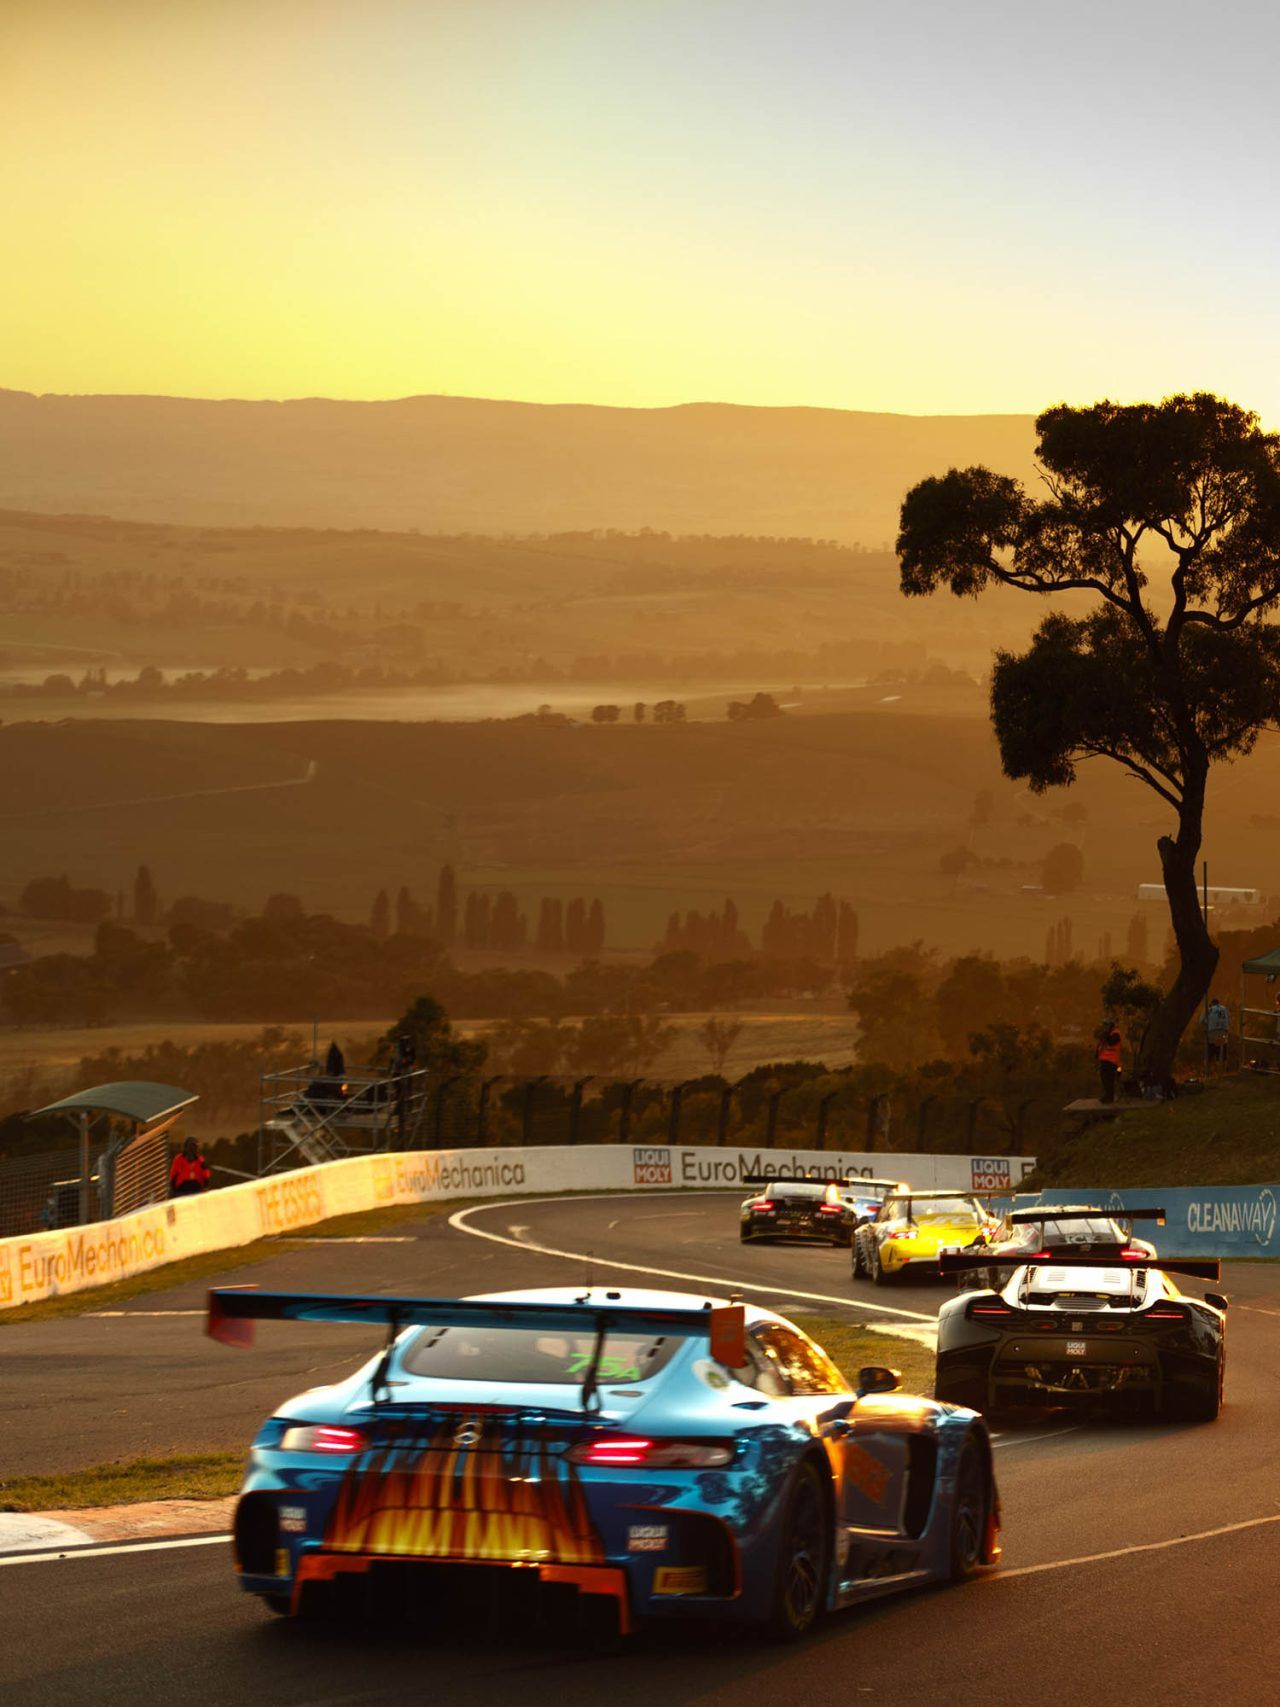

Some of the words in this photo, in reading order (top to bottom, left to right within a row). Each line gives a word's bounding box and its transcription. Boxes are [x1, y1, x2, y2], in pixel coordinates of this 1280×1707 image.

[635, 1149, 670, 1165] LIQUI
[395, 1156, 525, 1193] EuroMechanica
[635, 1166, 672, 1183] MOLY
[973, 1160, 1009, 1174] LIQUI
[973, 1175, 1010, 1189] MOLY
[1188, 1202, 1272, 1233] CLEANAWAY
[18, 1219, 166, 1292] EuroMechanica
